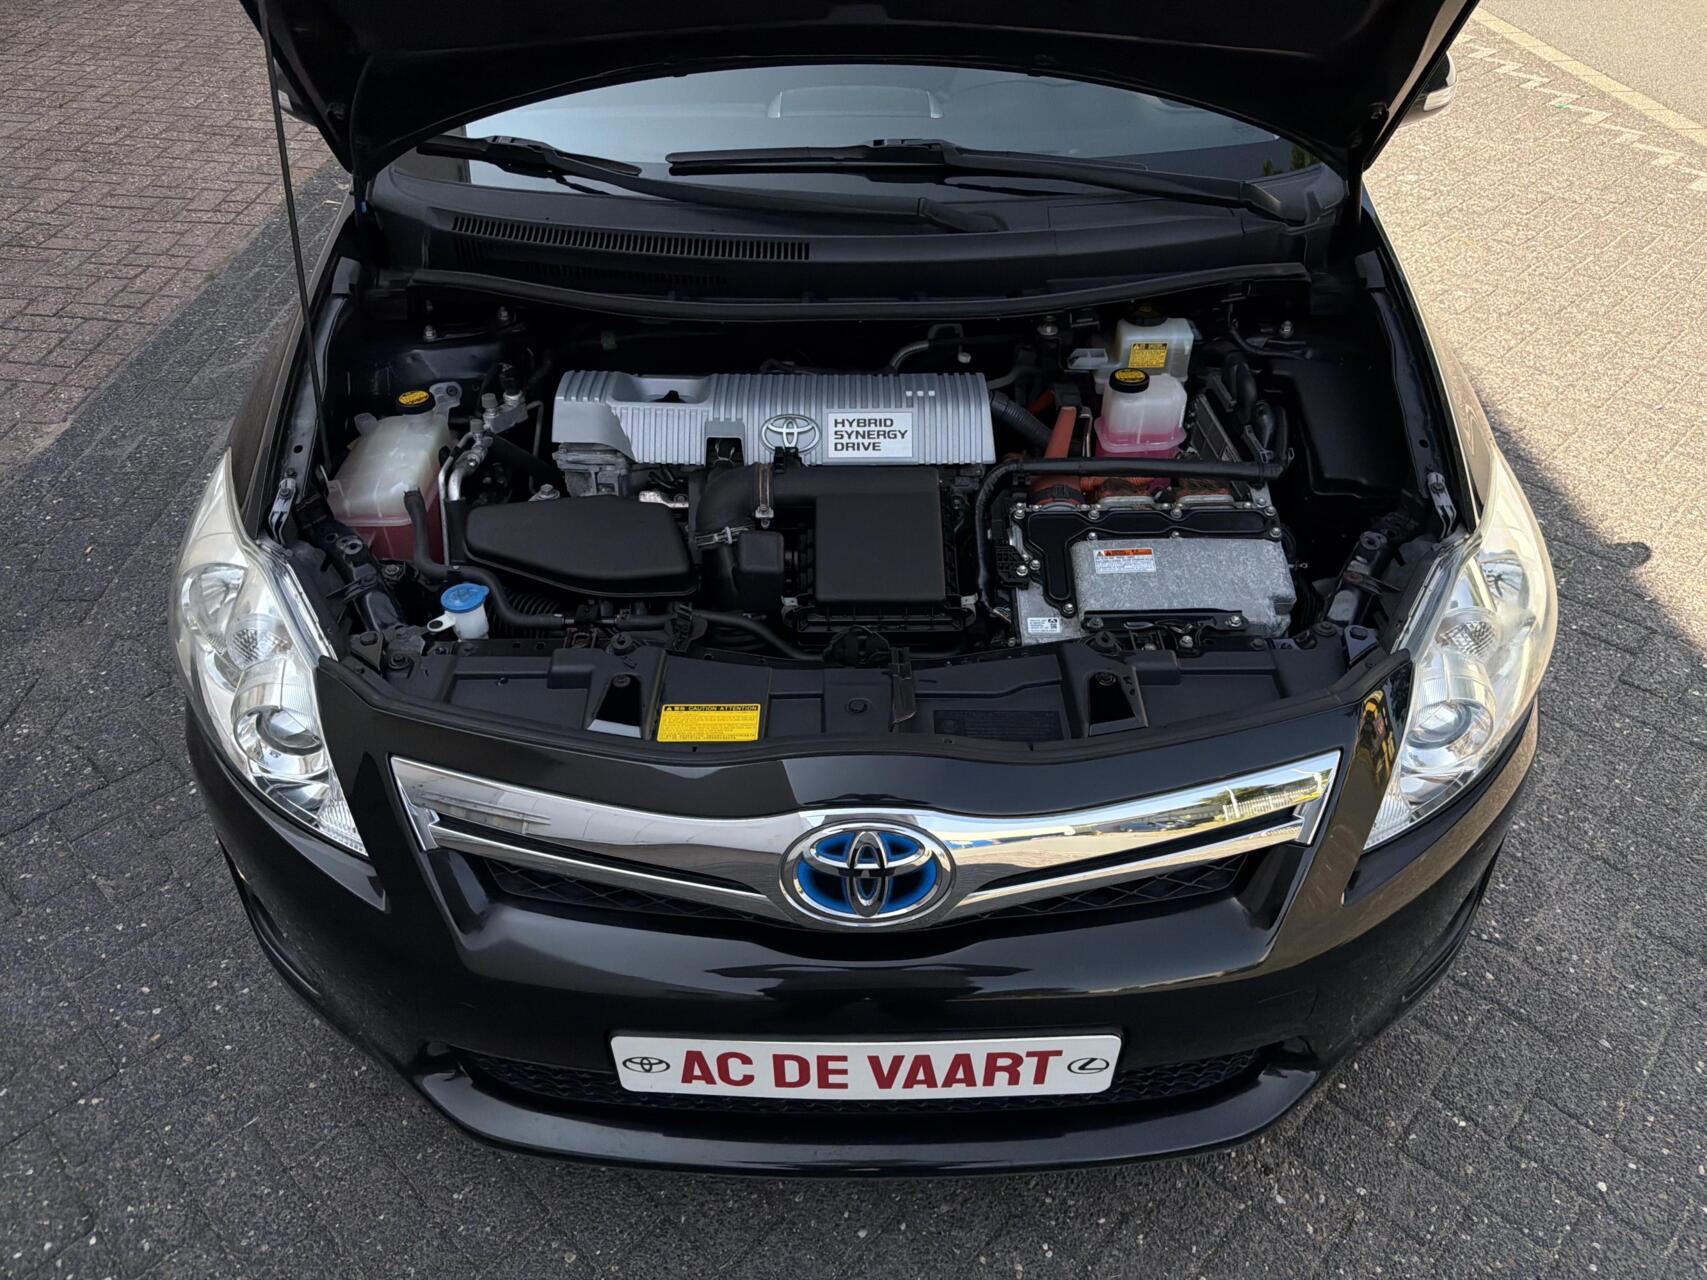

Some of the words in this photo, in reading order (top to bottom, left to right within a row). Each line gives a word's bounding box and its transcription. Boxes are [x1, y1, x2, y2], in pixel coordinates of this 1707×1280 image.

[834, 418, 894, 428] HYBRID
[834, 430, 908, 440] SYNERGY
[834, 442, 882, 452] DRIVE
[680, 1049, 755, 1087] AC
[771, 1053, 849, 1089] DE
[866, 1049, 1063, 1089] VAART
